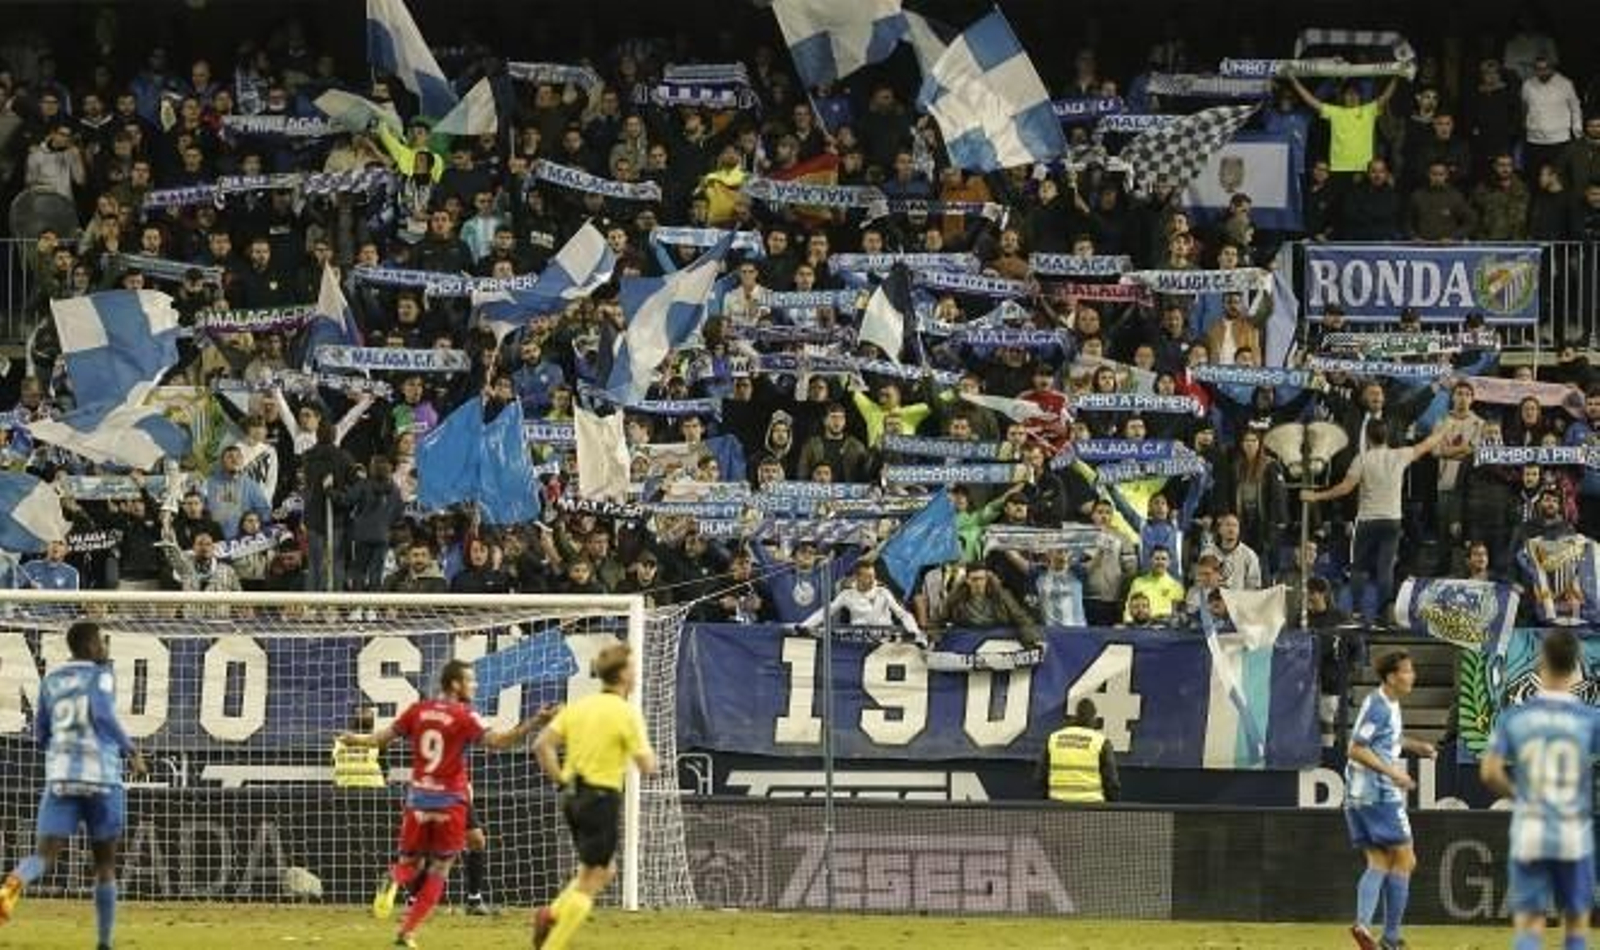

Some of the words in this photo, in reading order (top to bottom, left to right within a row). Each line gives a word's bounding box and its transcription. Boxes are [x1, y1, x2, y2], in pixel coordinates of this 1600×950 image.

[1309, 260, 1475, 308] RONDA
[774, 636, 1143, 753] 1904
[419, 728, 445, 774] 9
[1517, 735, 1581, 806] 10
